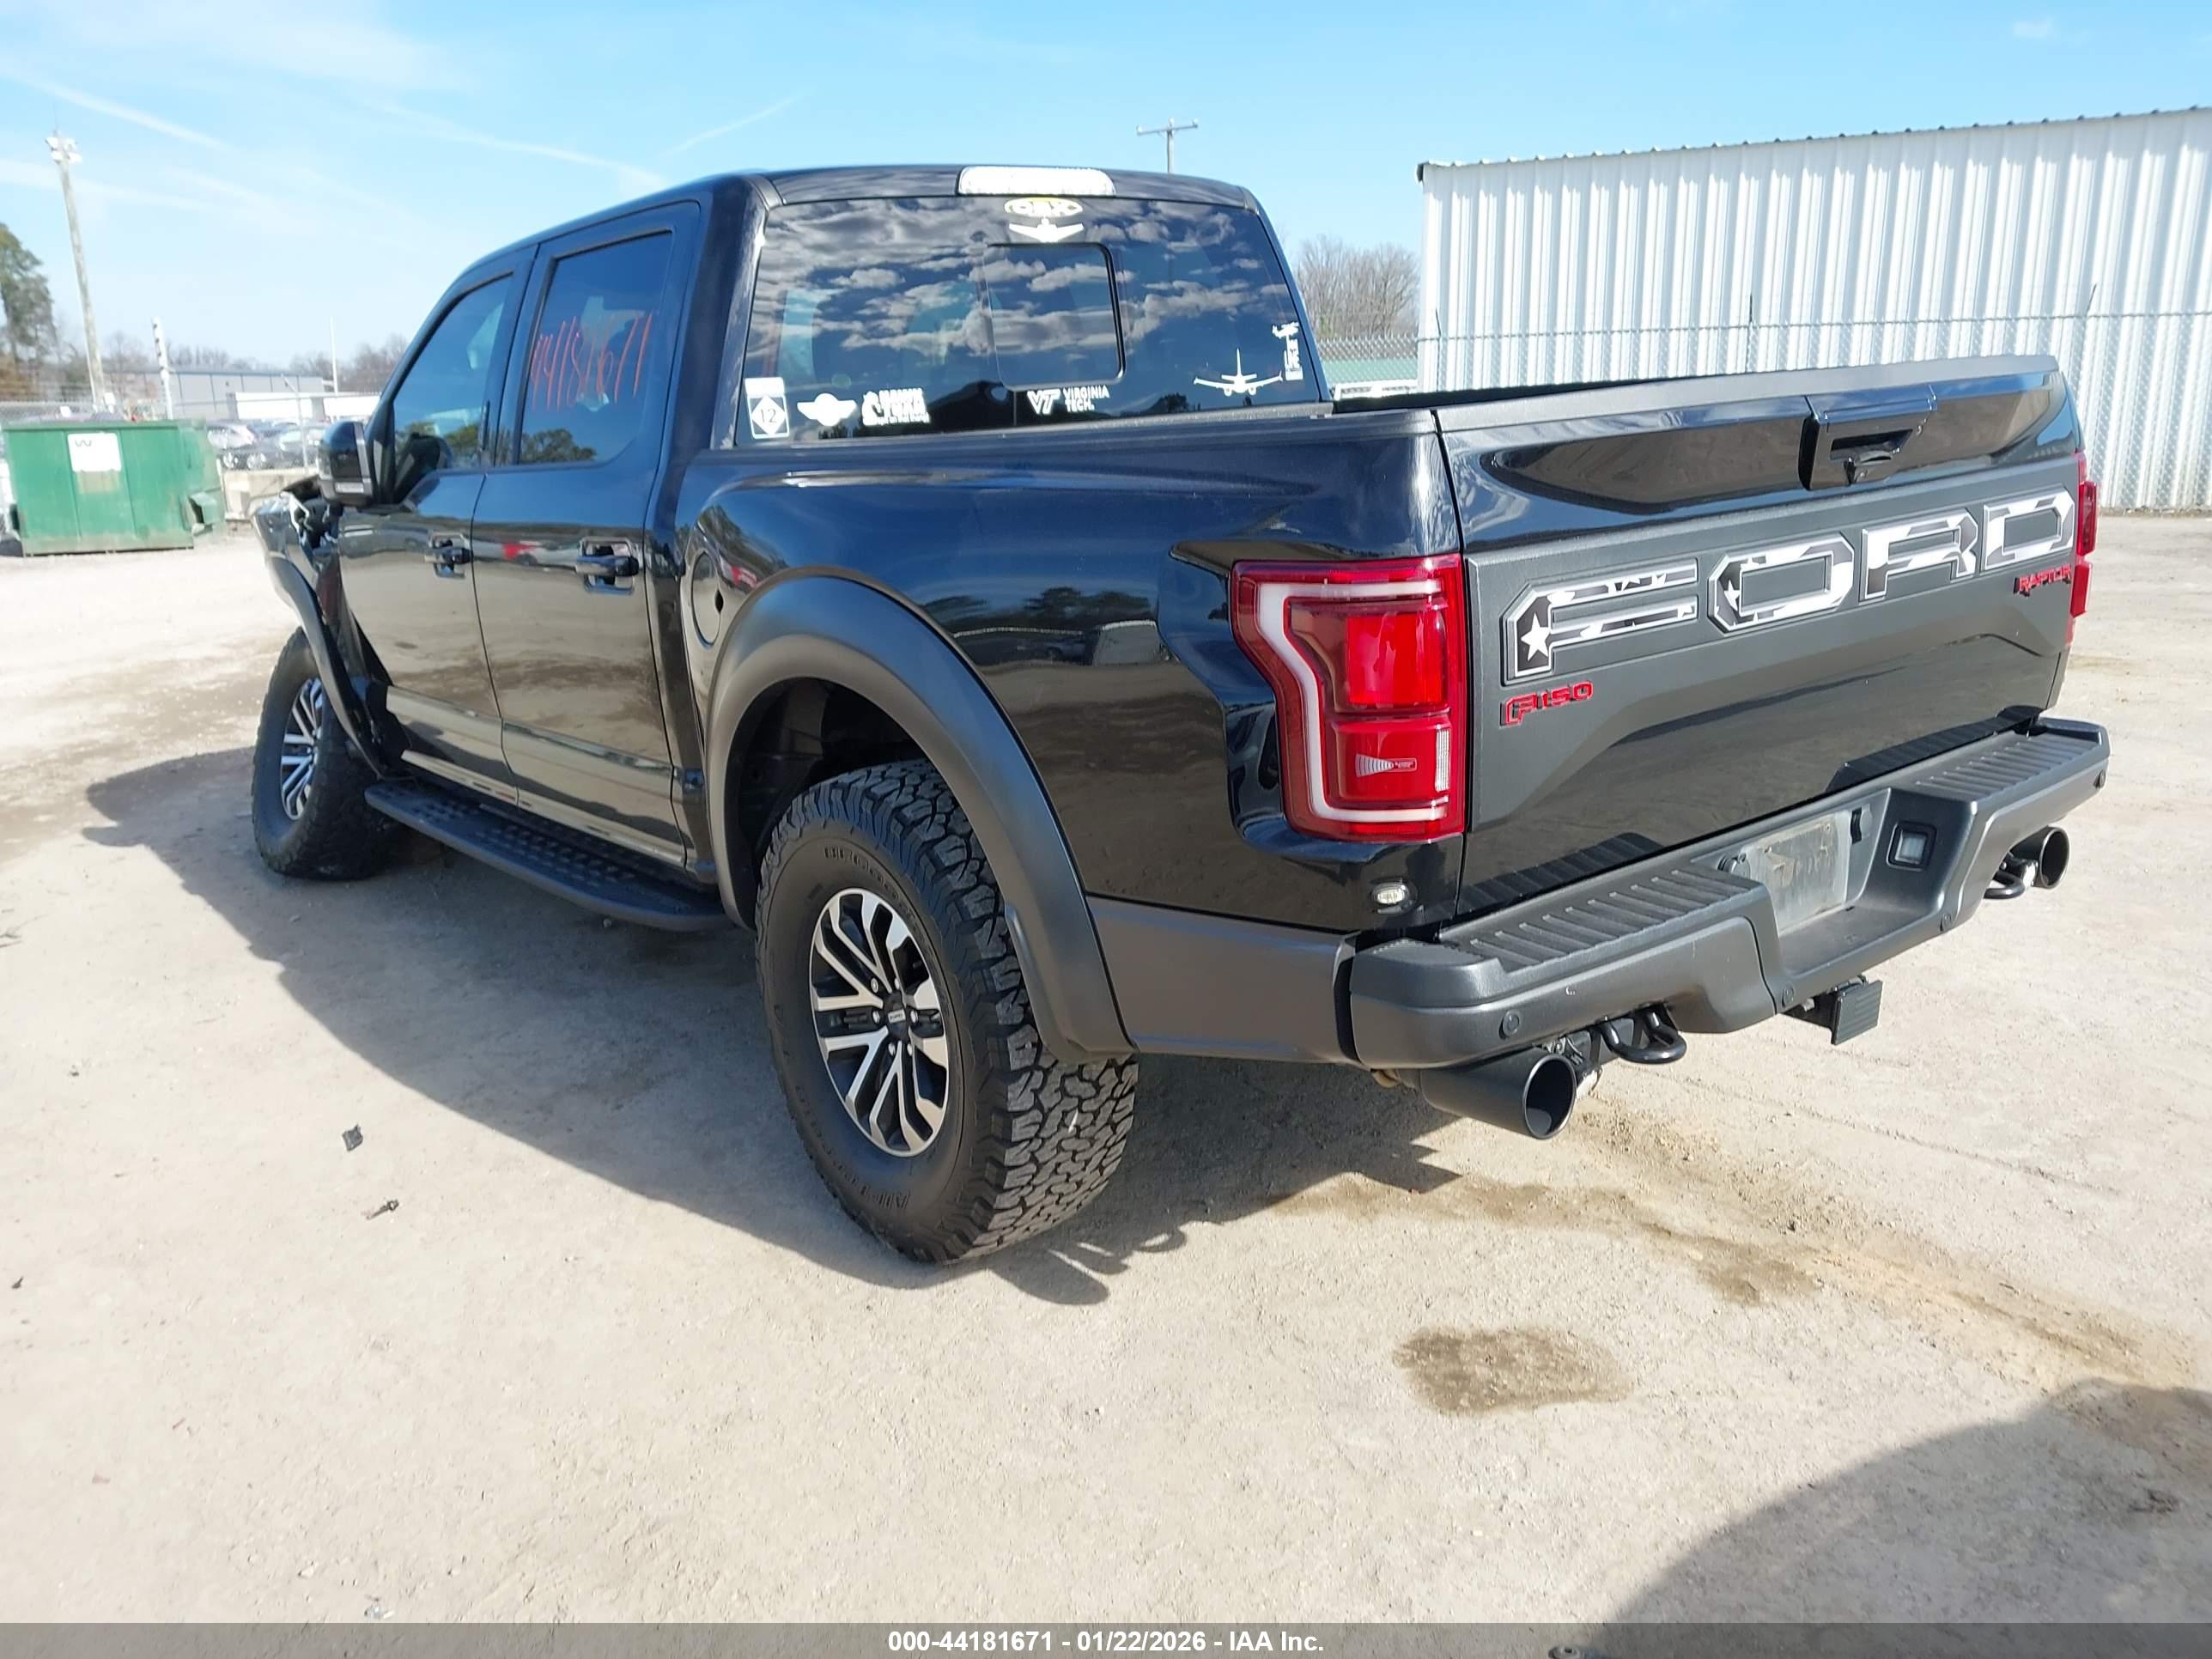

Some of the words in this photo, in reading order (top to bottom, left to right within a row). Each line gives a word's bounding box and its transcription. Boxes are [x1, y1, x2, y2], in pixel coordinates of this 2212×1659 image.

[1026, 388, 1061, 415] VT
[1062, 384, 1110, 400] VIRGINIA
[761, 408, 777, 423] 12
[1504, 490, 2075, 683] FORD
[2015, 563, 2072, 595] RAPTOR
[1501, 680, 1594, 726] F150
